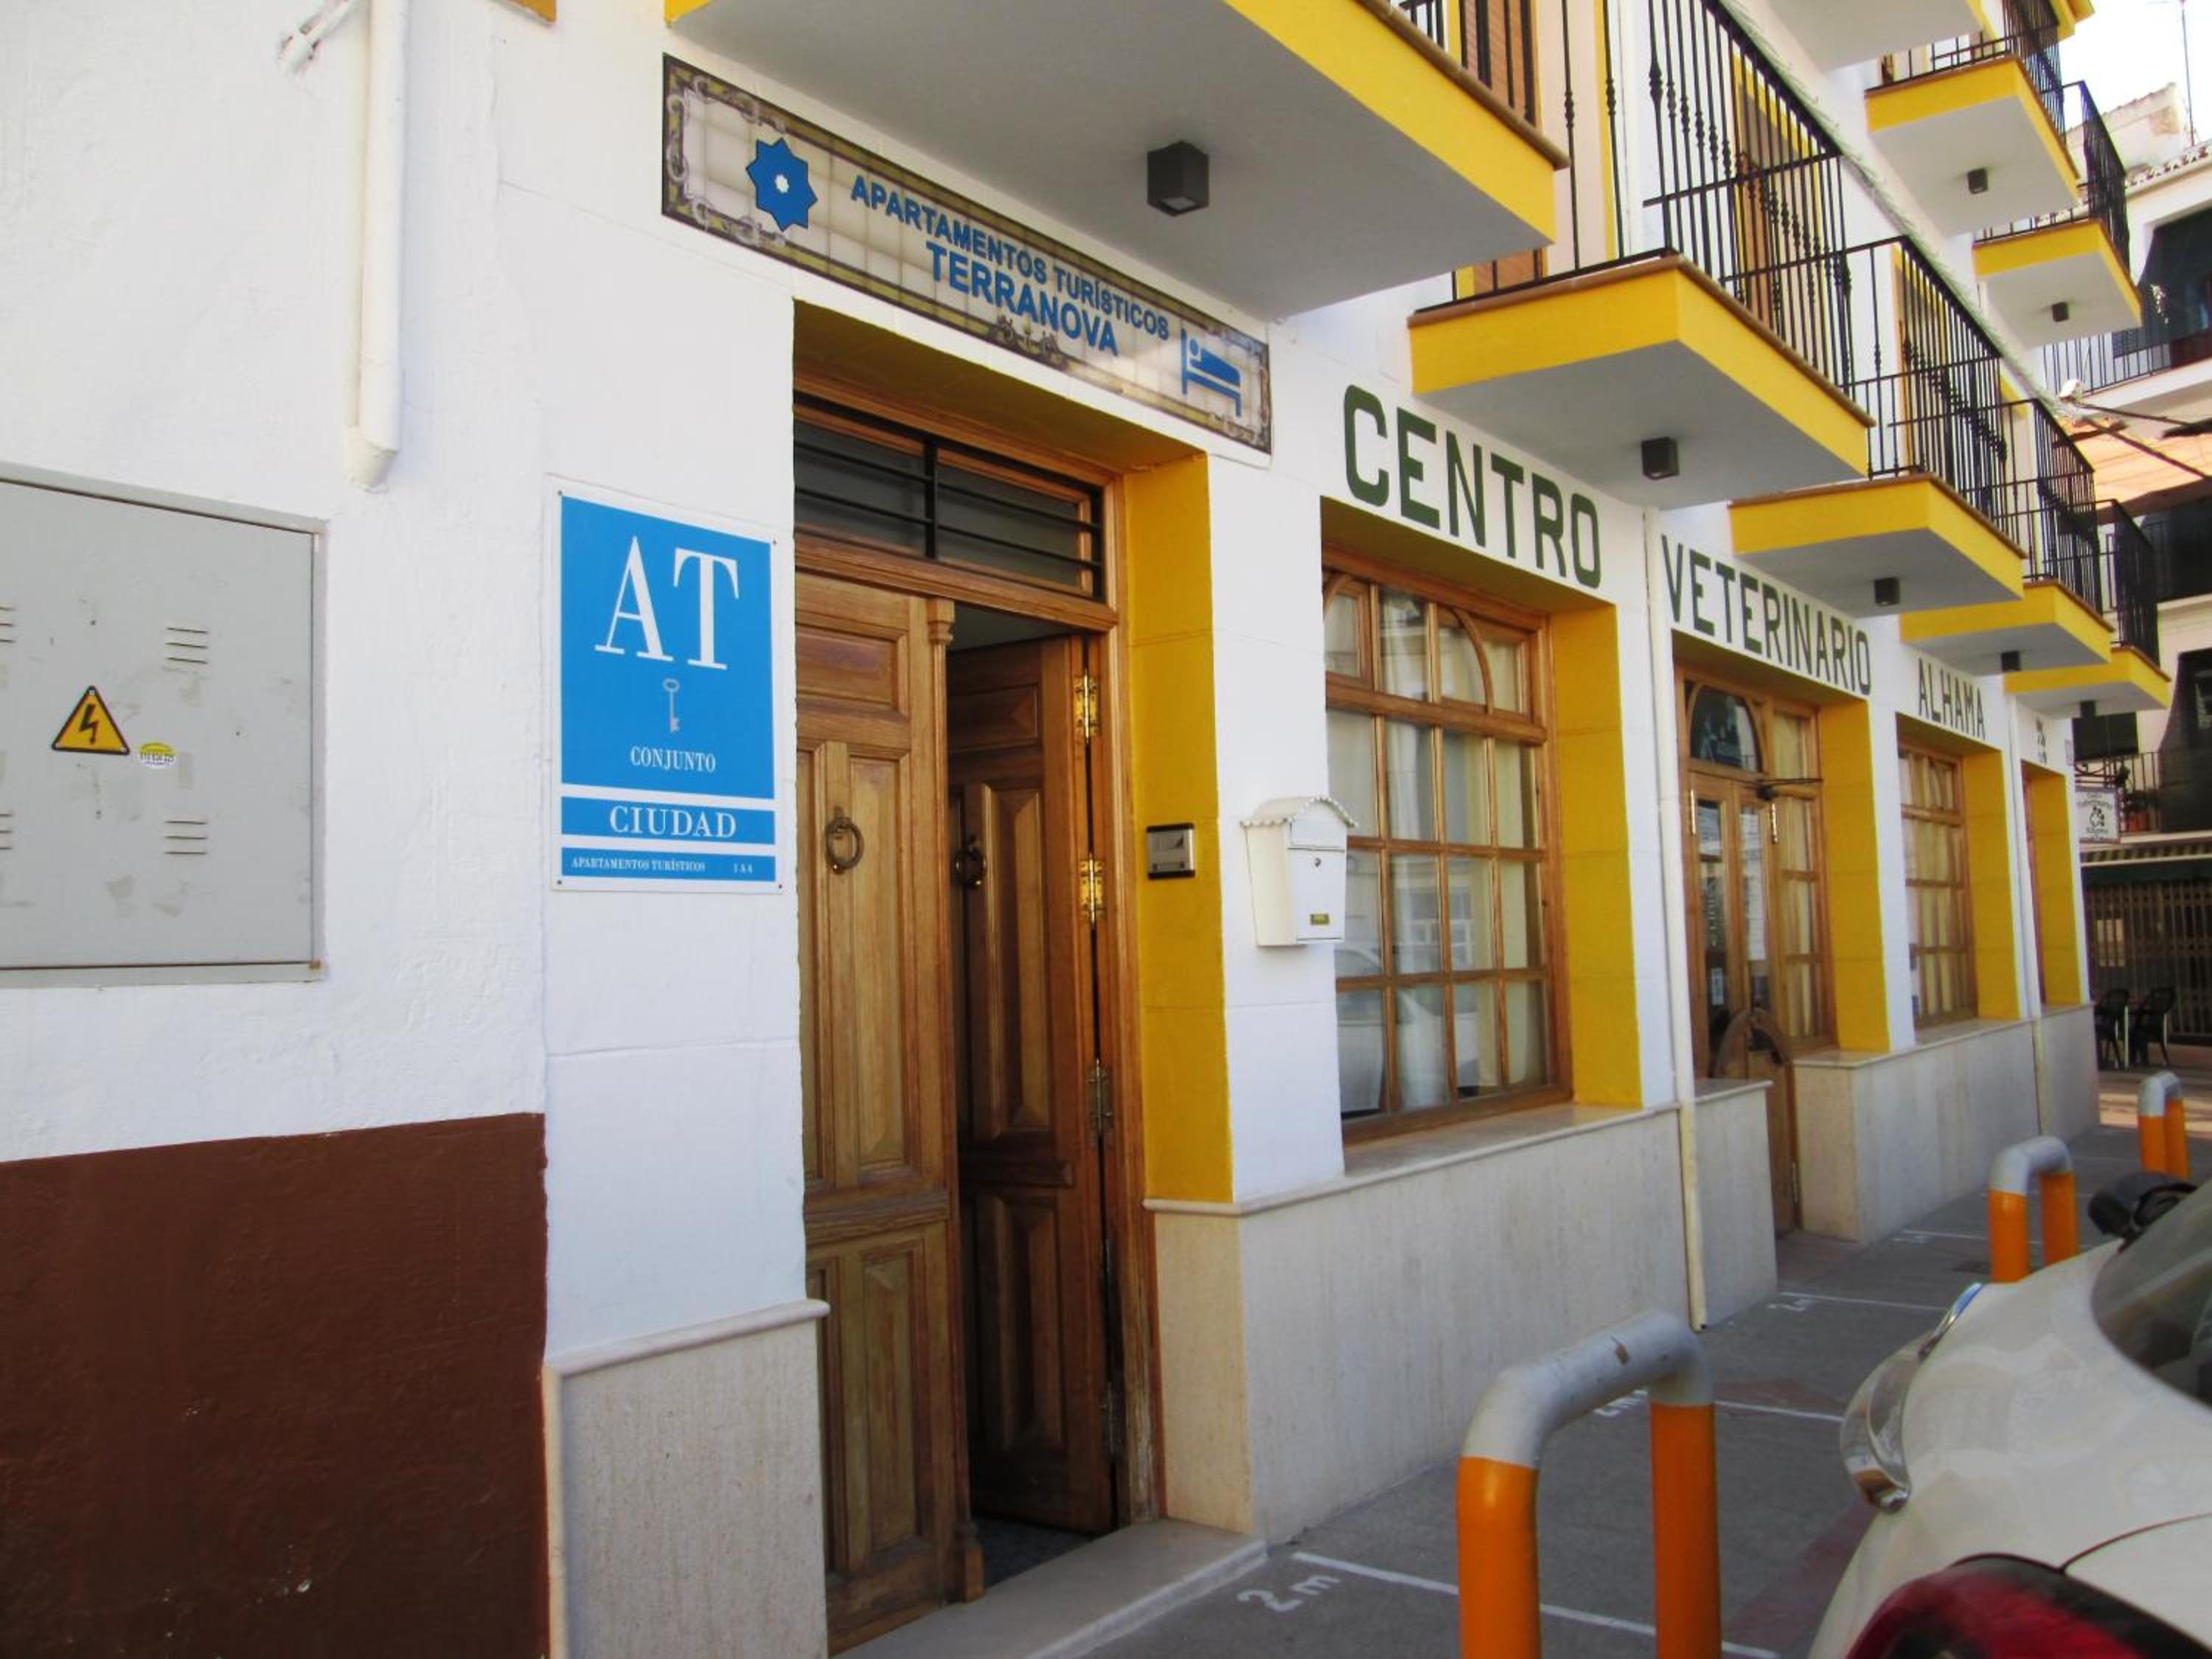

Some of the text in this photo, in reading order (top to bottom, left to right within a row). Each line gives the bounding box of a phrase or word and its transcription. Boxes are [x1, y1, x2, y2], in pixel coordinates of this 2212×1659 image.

[850, 175, 1169, 341] APARTAMENTOS TURÍSTICOS
[925, 240, 1119, 356] TERRANOVA
[594, 535, 740, 670] AT
[1343, 384, 1986, 740] CENTRO VETERINARIO ALHAMA
[630, 745, 716, 772] CONJUNTO
[571, 857, 650, 871] APARTAMENTOS
[609, 805, 737, 838] CIUDAD
